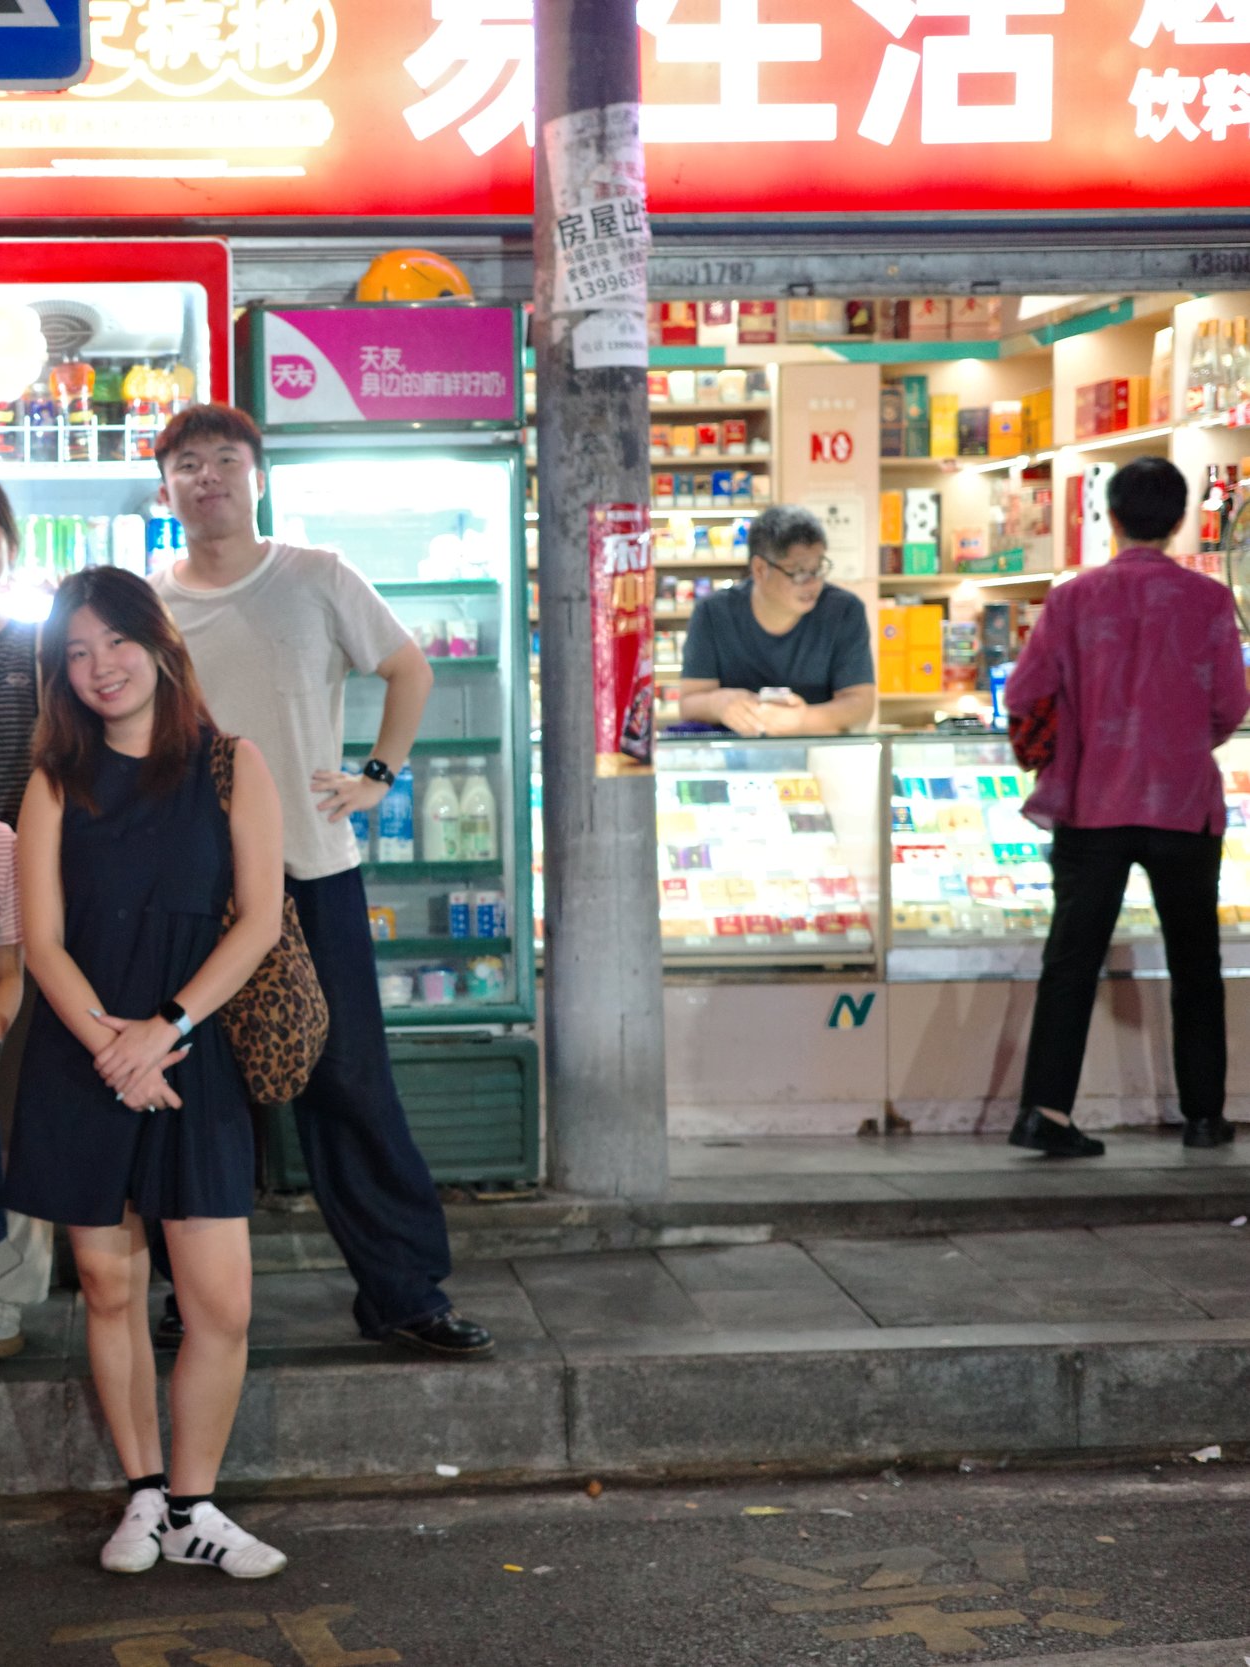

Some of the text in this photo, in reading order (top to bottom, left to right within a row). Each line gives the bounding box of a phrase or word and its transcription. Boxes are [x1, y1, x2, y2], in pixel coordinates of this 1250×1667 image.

[558, 198, 647, 251] 房屋出
[272, 363, 315, 389] 天友
